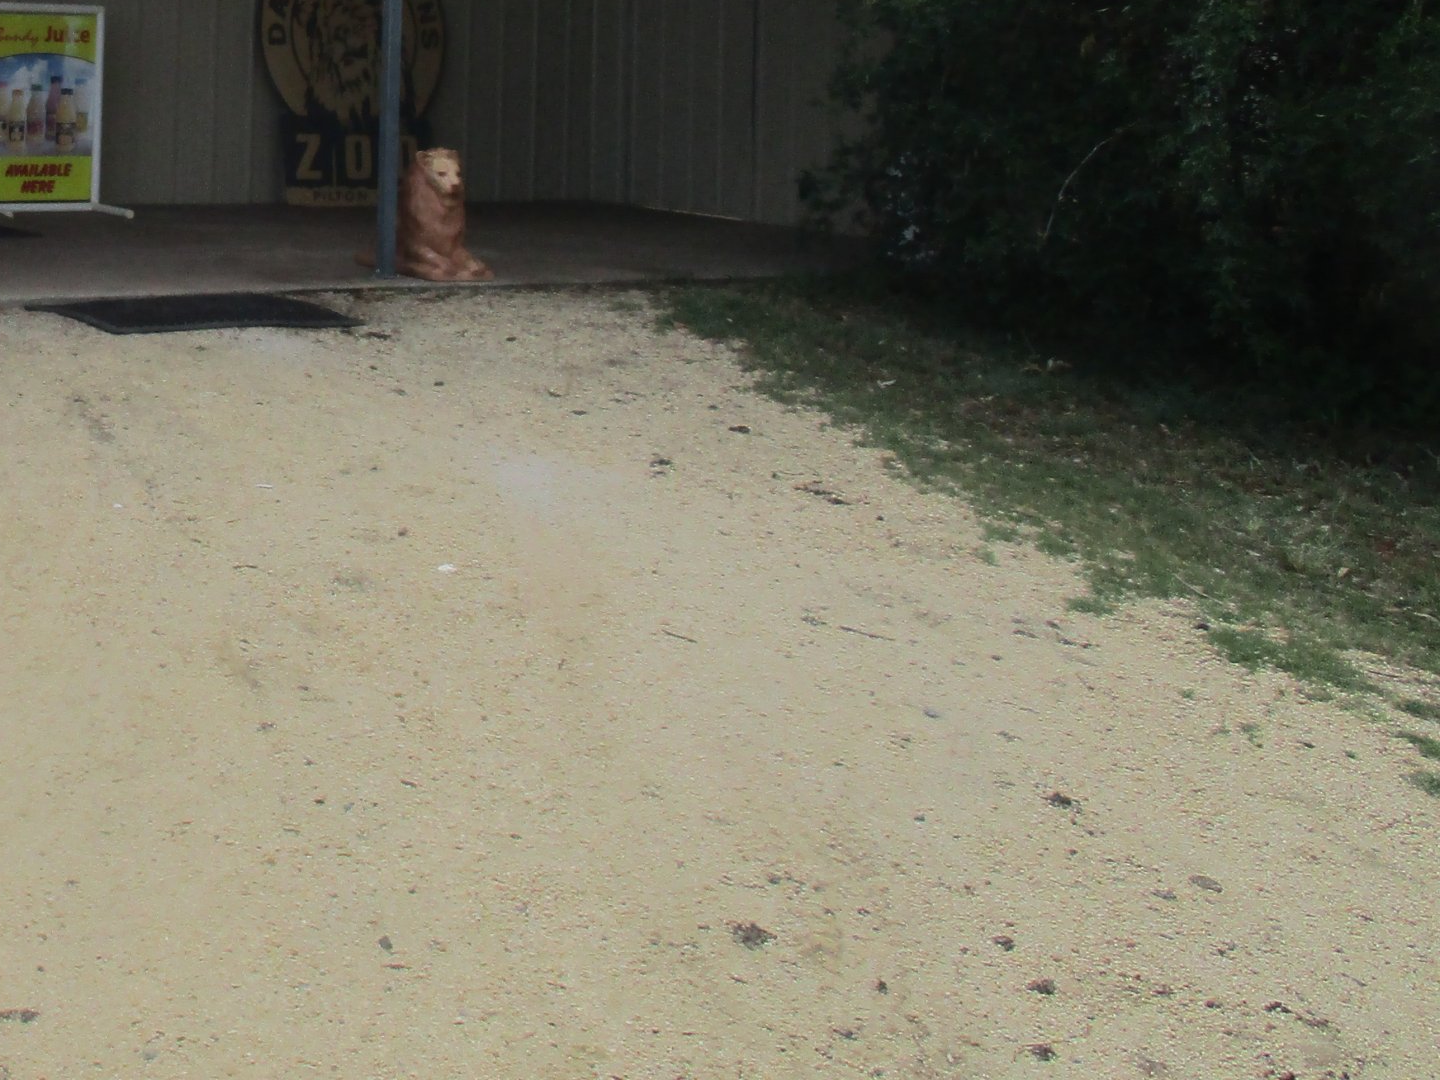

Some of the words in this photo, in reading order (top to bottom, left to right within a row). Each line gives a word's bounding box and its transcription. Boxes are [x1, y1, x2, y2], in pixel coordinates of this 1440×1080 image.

[5, 163, 72, 178] AVAILABLE
[20, 180, 56, 194] HERE
[313, 189, 368, 202] PILTON
